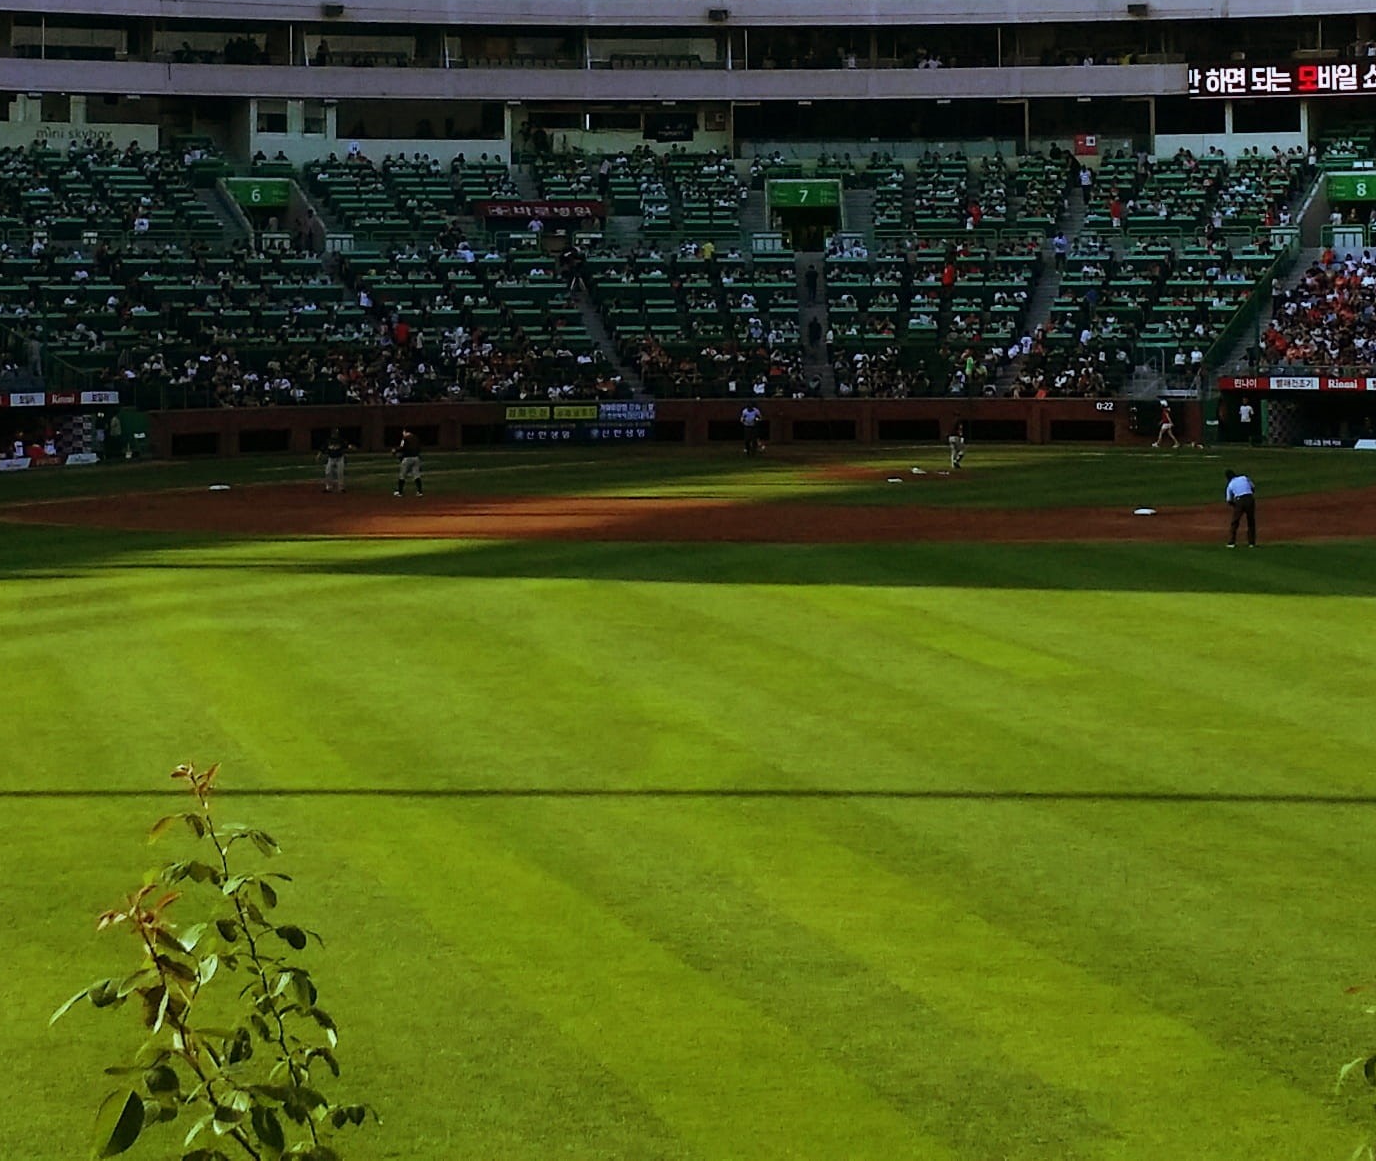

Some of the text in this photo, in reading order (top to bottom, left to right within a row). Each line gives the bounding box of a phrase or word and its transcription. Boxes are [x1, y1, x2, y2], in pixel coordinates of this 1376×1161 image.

[1205, 67, 1246, 93] 하면
[1251, 66, 1292, 92] 되는
[1298, 63, 1357, 91] 모바일
[36, 126, 112, 138] mini skybox
[251, 188, 261, 203] 6
[799, 189, 809, 203] 7
[1356, 182, 1367, 197] 8
[1328, 379, 1357, 390] Rinnai
[1096, 401, 1114, 411] 0:22
